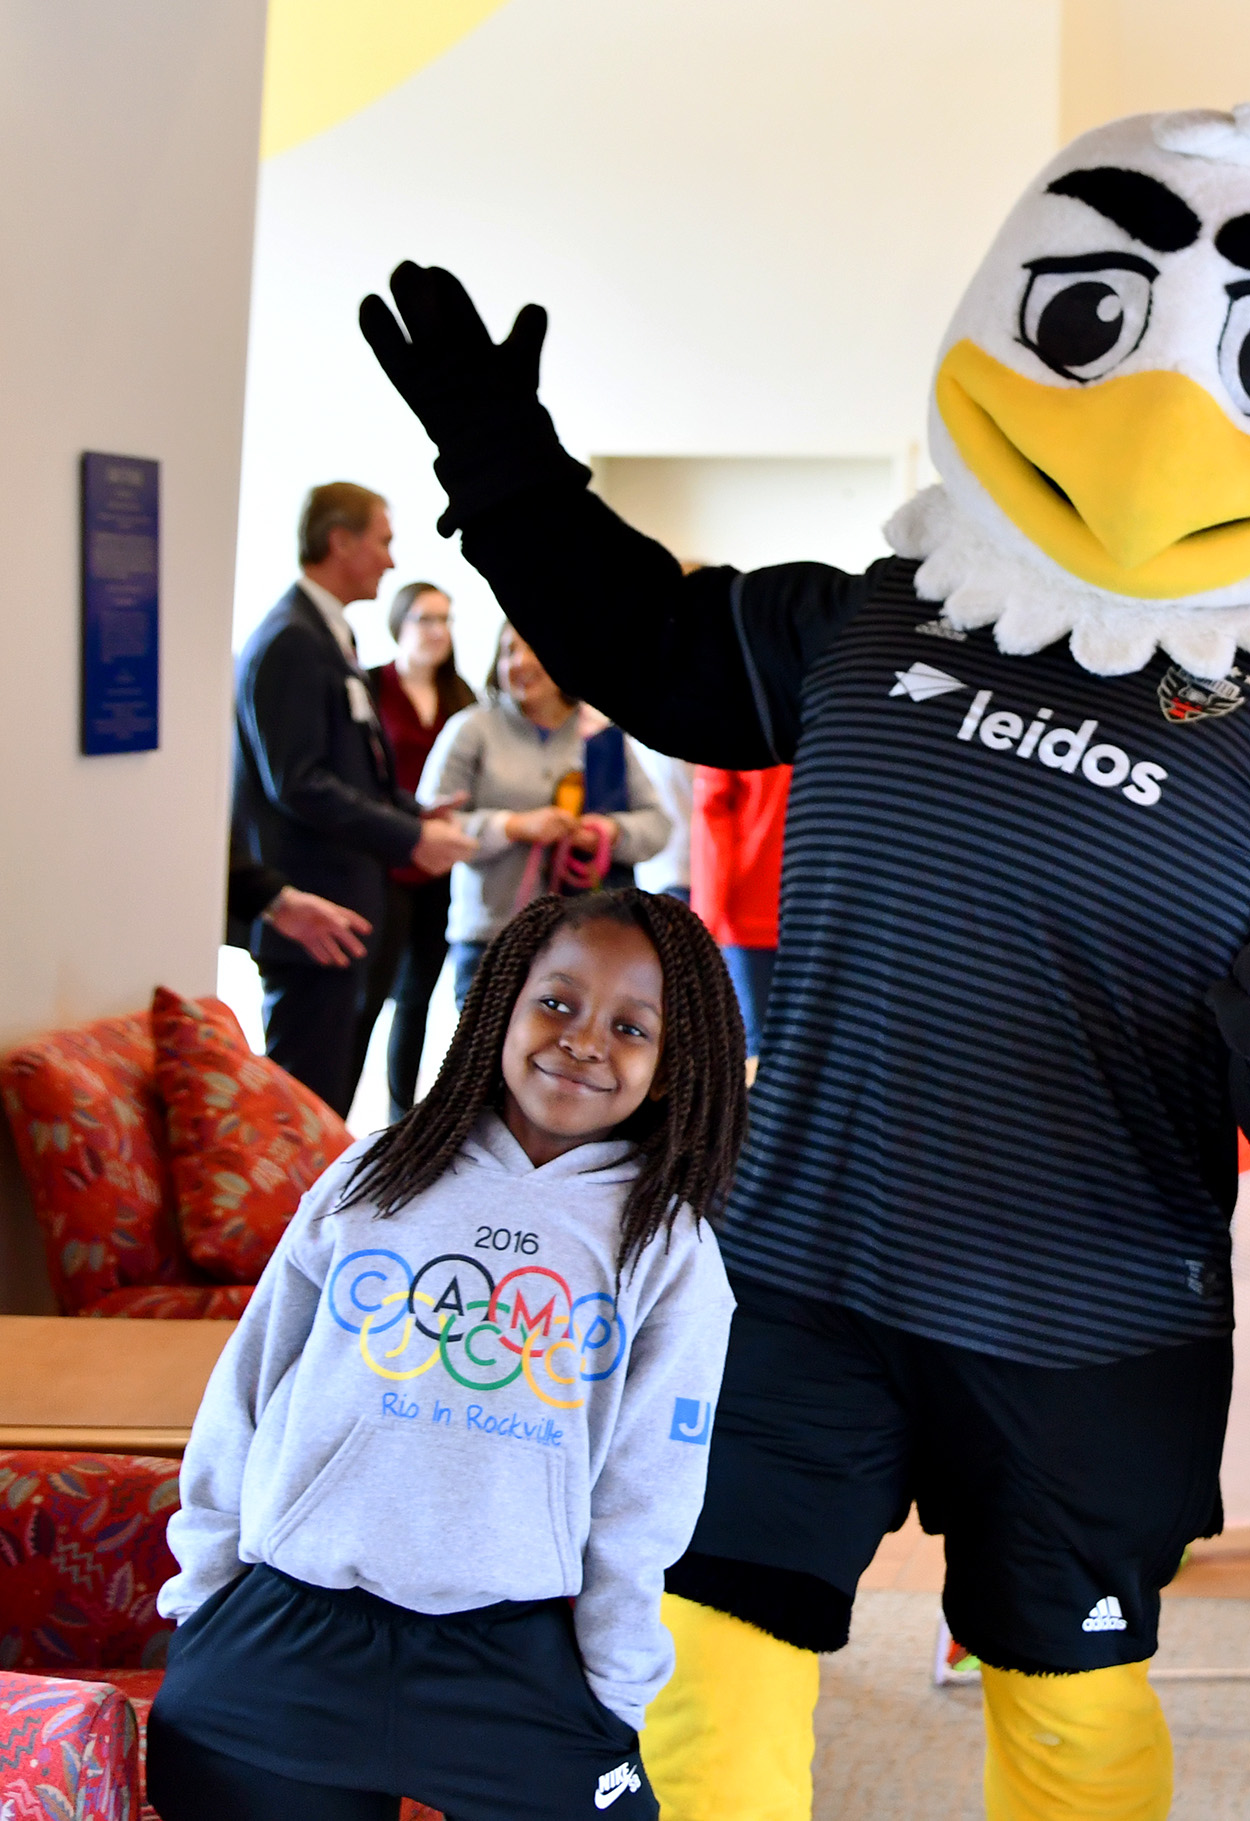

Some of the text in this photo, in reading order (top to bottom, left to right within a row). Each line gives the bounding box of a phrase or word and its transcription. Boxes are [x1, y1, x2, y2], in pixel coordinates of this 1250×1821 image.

[957, 690, 1168, 806] leidos
[474, 1226, 539, 1255] 2016
[350, 1270, 612, 1354] CAMP
[382, 1392, 564, 1447] Rio In Rockville
[598, 1761, 630, 1793] NIKE
